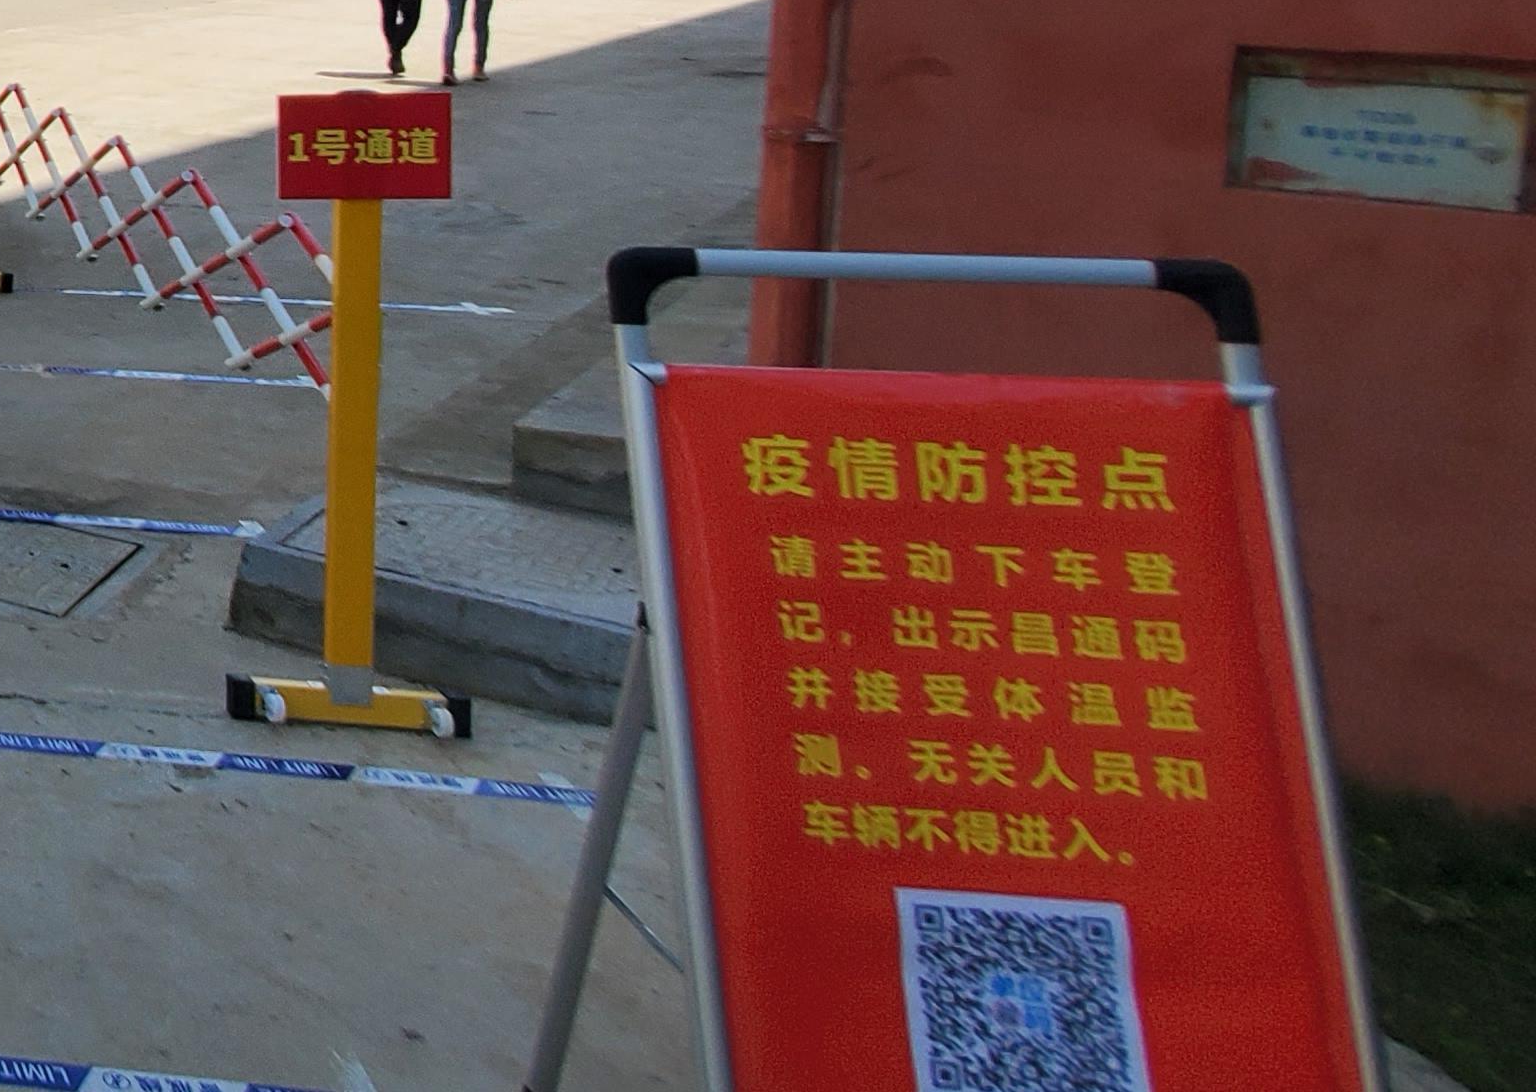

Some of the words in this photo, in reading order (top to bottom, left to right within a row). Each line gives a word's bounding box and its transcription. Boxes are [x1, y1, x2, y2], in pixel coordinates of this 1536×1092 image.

[287, 127, 440, 165] 1号通道
[740, 432, 1175, 513] 疫情防控点
[769, 533, 1178, 598] 请主动下车登
[787, 665, 1200, 734] 并接受体温监
[803, 800, 1134, 867] 车辆不得进入。
[0, 1059, 70, 1086] LIMIT
